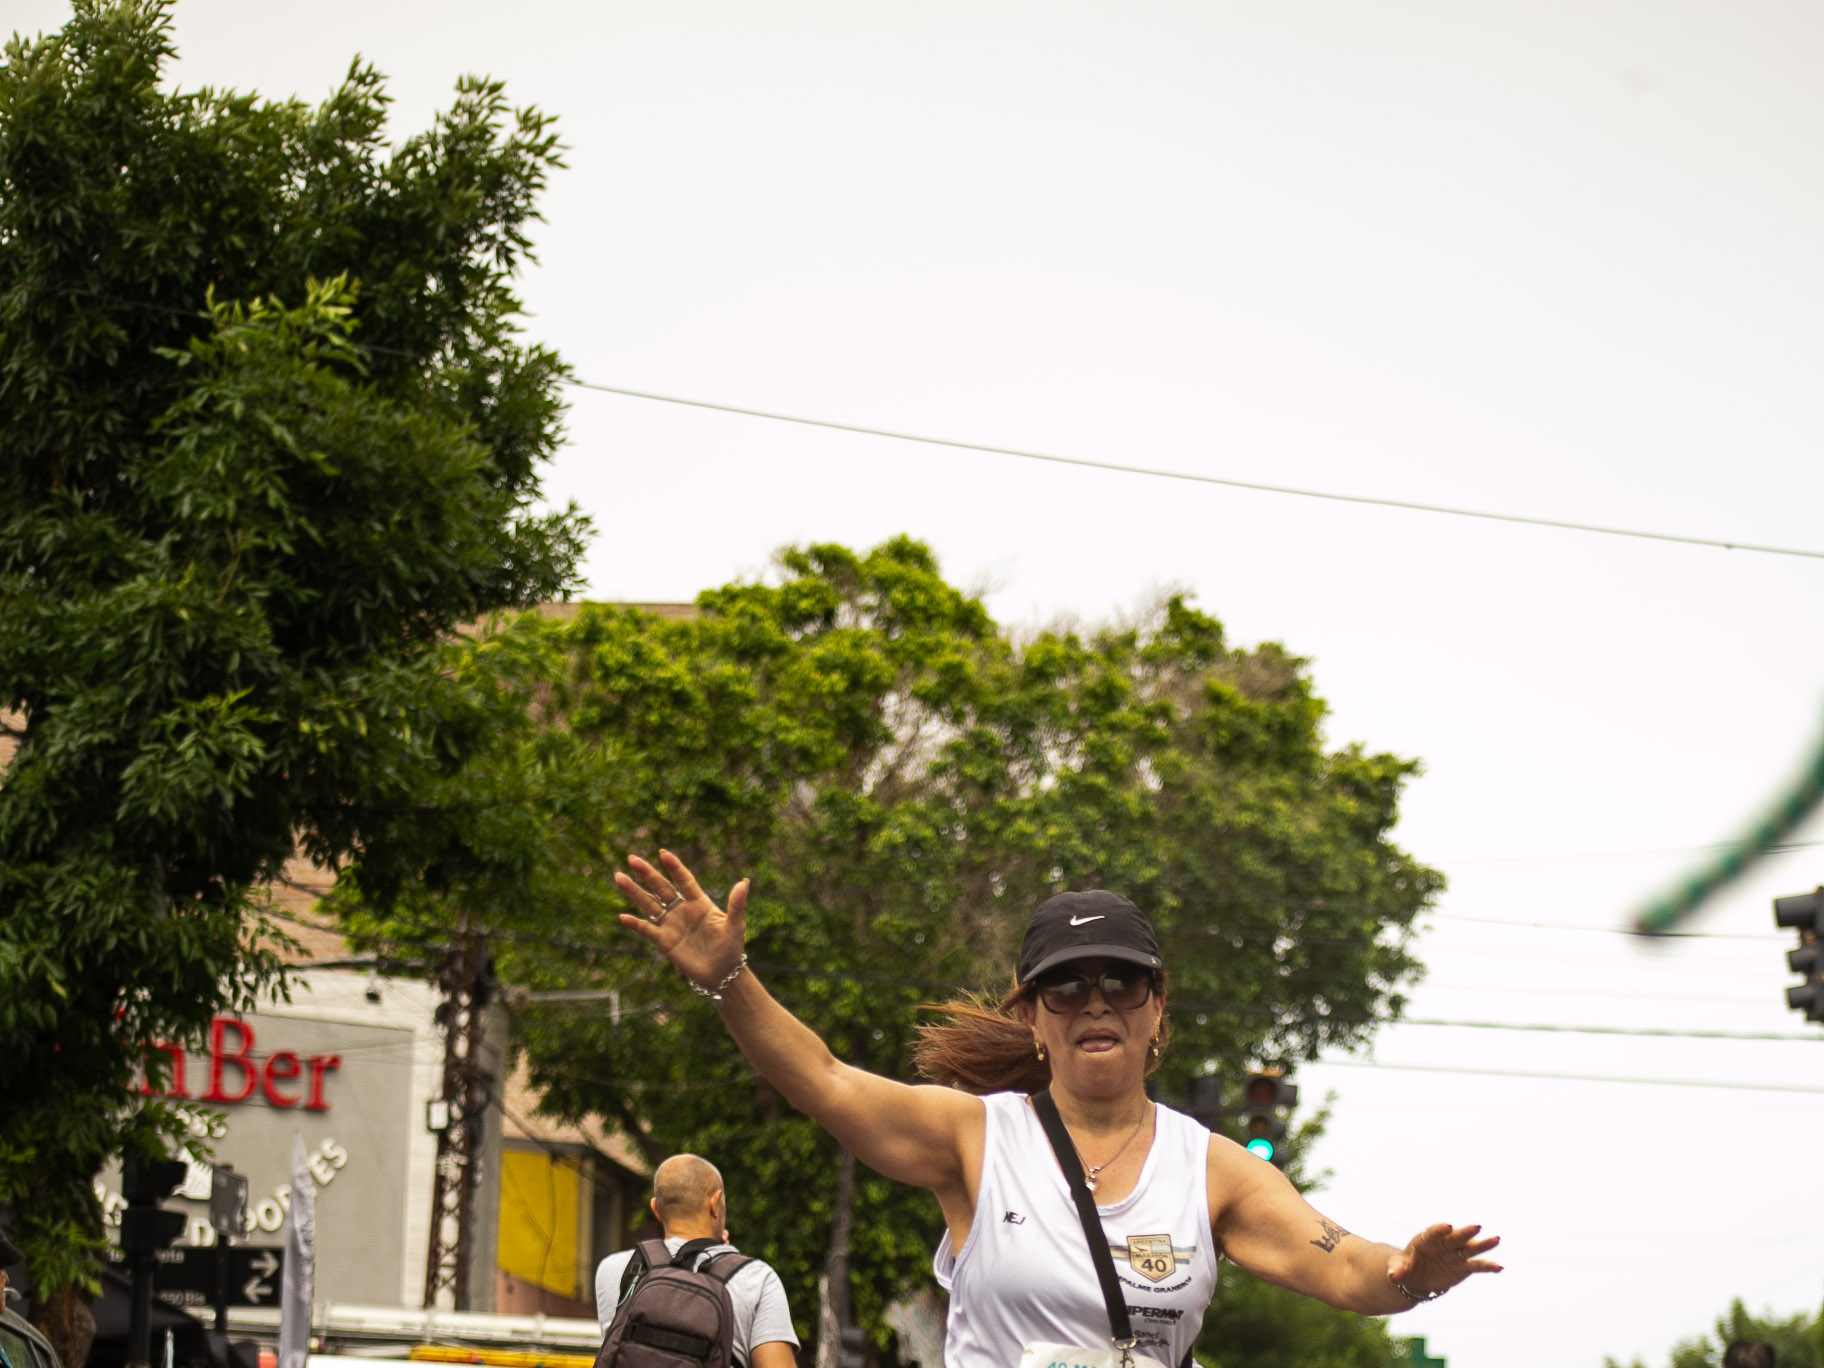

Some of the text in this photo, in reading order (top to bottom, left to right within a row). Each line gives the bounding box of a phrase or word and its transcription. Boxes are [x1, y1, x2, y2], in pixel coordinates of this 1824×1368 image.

[1003, 1211, 1026, 1225] NEJ
[1141, 1258, 1167, 1273] 40
[1118, 1275, 1192, 1293] PALME GRANEROS
